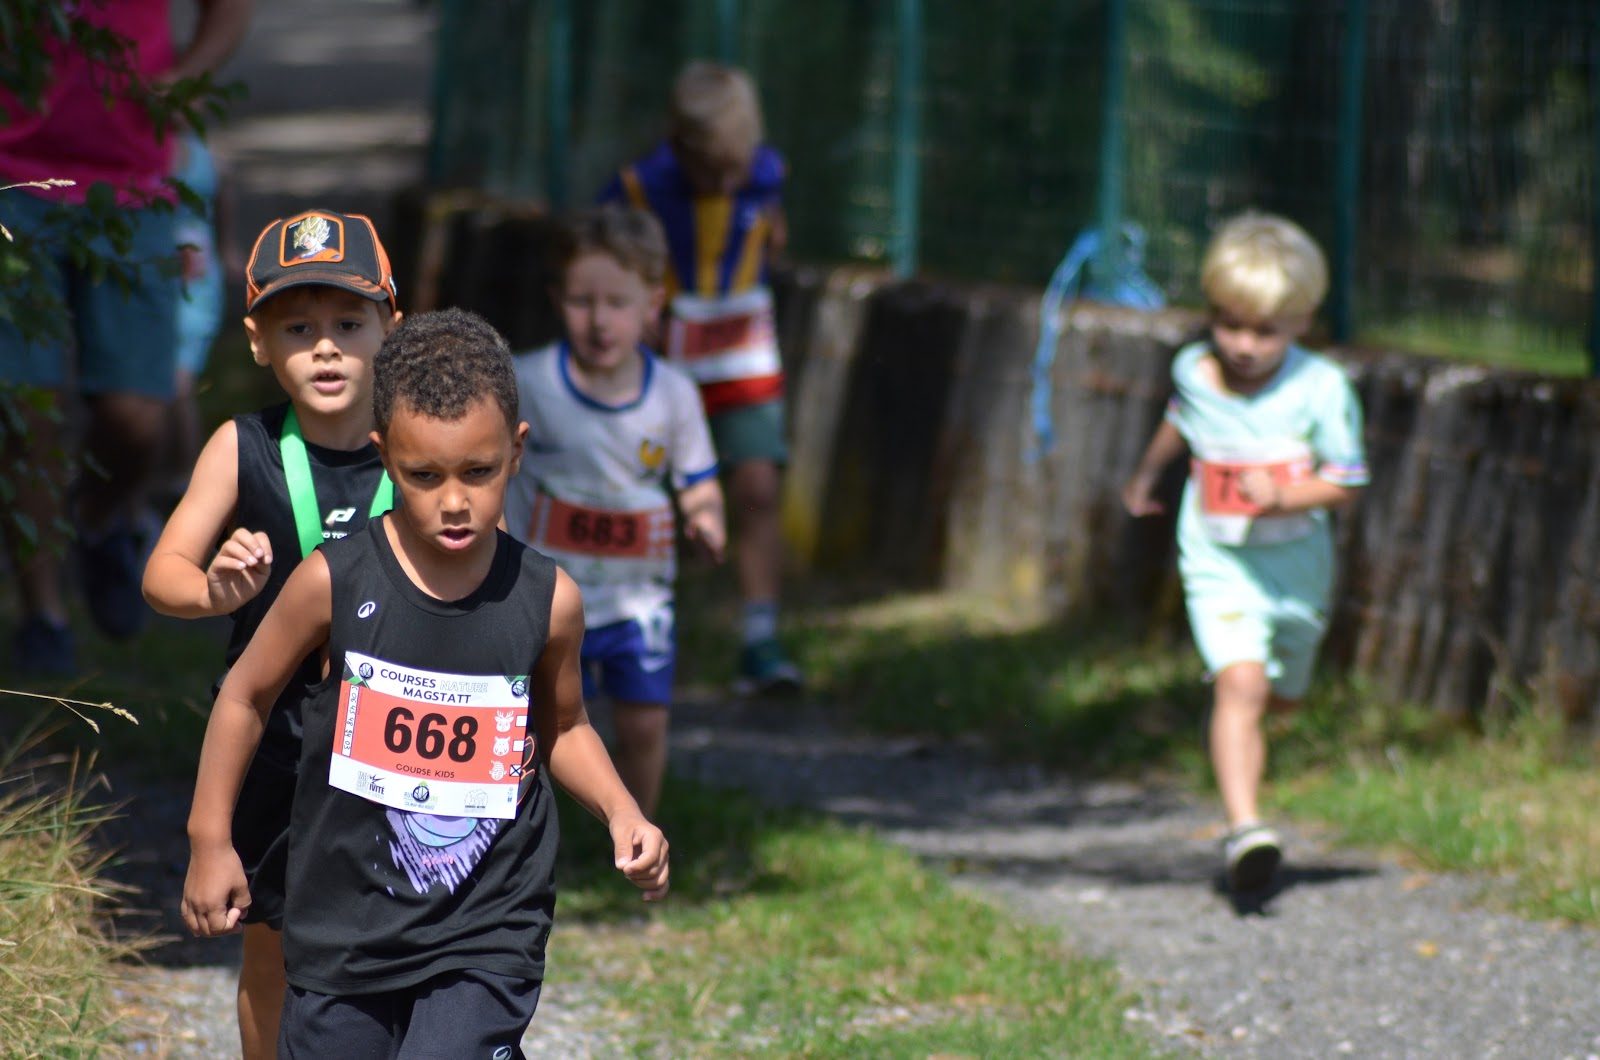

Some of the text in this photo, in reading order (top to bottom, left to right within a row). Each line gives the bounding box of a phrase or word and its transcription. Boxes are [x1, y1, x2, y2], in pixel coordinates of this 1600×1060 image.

[568, 511, 637, 547] 683
[380, 668, 489, 694] COURSES NATURE
[402, 686, 472, 704] MAGSTATT
[384, 706, 479, 763] 668
[395, 763, 455, 779] COURSE KIDS
